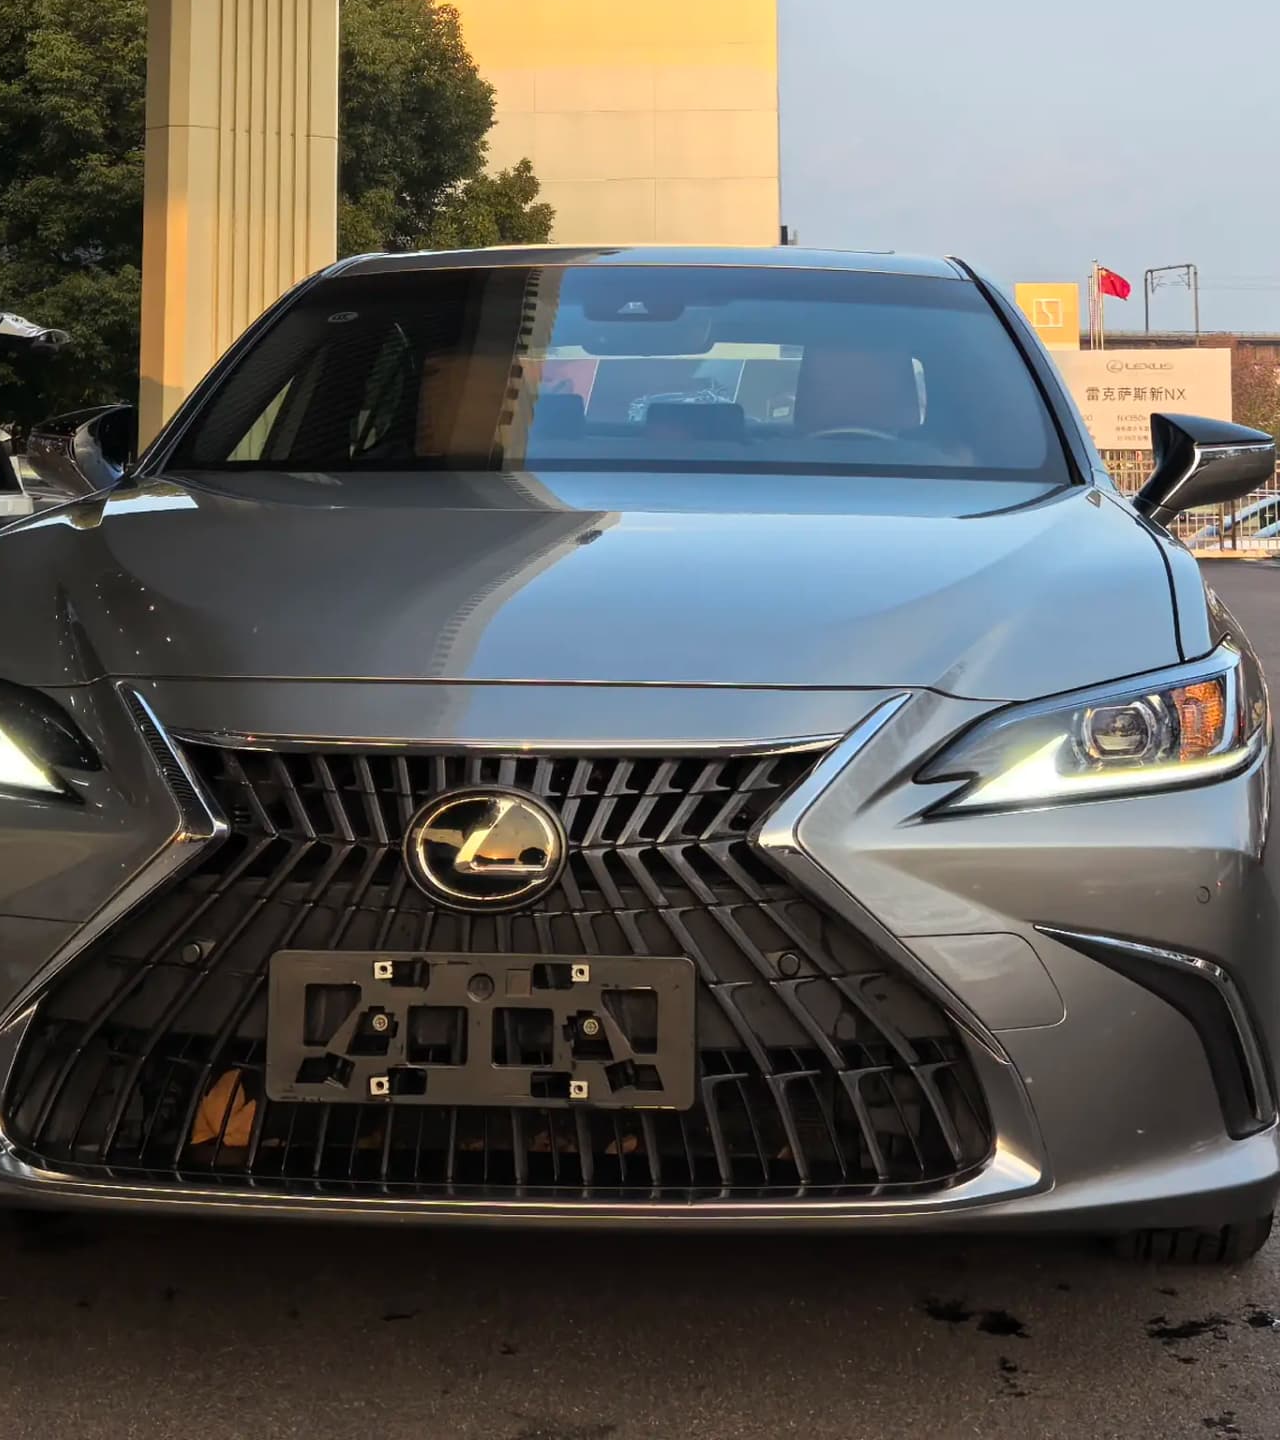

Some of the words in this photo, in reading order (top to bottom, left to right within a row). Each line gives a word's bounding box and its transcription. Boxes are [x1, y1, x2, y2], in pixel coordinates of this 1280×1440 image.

[1086, 386, 1187, 402] 雷克萨斯新NX
